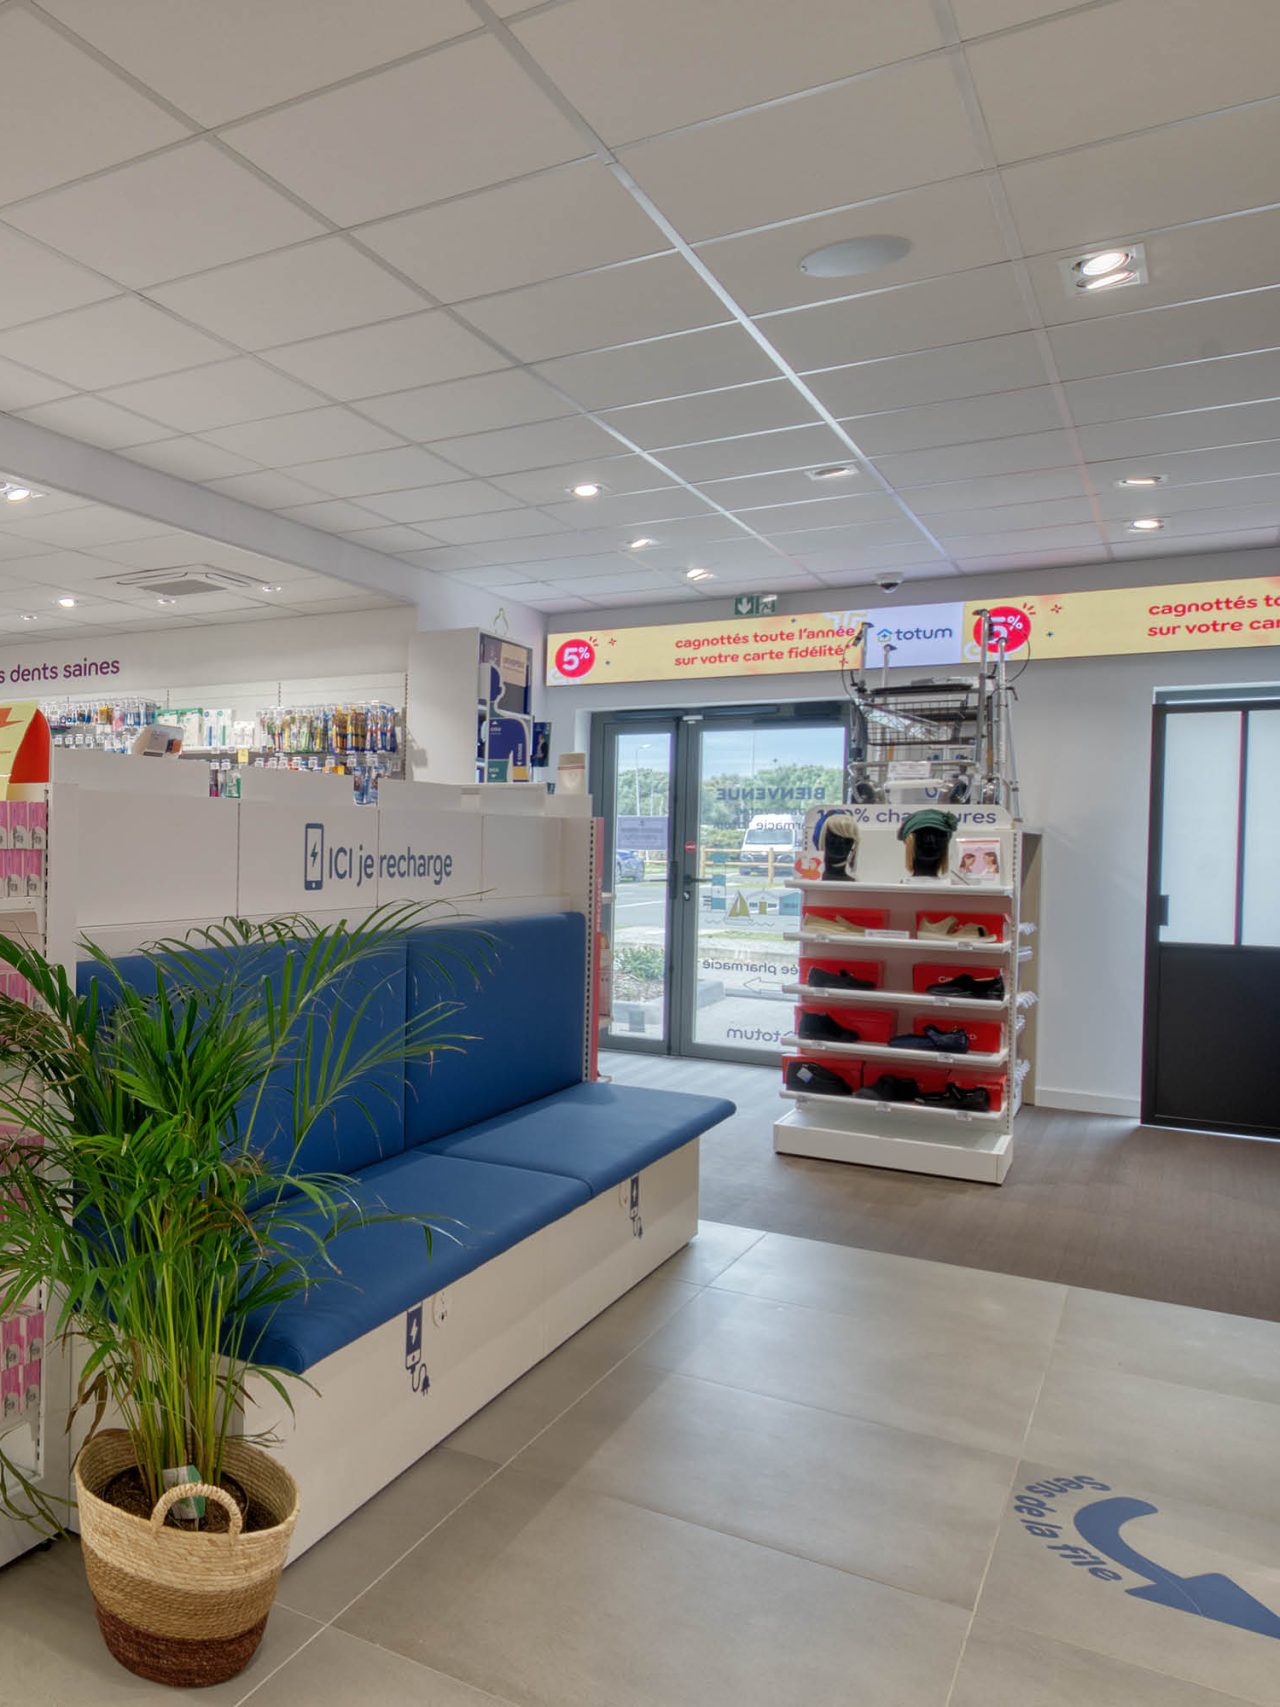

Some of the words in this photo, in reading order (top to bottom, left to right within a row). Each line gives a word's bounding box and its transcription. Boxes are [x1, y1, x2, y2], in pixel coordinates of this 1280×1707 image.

[1148, 596, 1258, 618] cagnottés
[674, 632, 749, 651] cagnottés
[753, 628, 794, 643] toute
[894, 626, 953, 641] totum
[1147, 625, 1181, 637] sur
[1185, 620, 1243, 634] votre
[9, 663, 59, 684] dents
[63, 656, 121, 679] saines
[562, 646, 590, 671] 5%
[674, 656, 698, 667] sur
[700, 650, 738, 664] votre
[742, 650, 784, 662] carte
[875, 808, 998, 824] chaures
[328, 847, 353, 880] ICI
[356, 844, 375, 888] je
[379, 846, 454, 887] recharge
[1024, 1475, 1111, 1498] Sens
[1013, 1494, 1057, 1518] de
[1019, 1518, 1063, 1538] la
[1046, 1543, 1122, 1581] file
